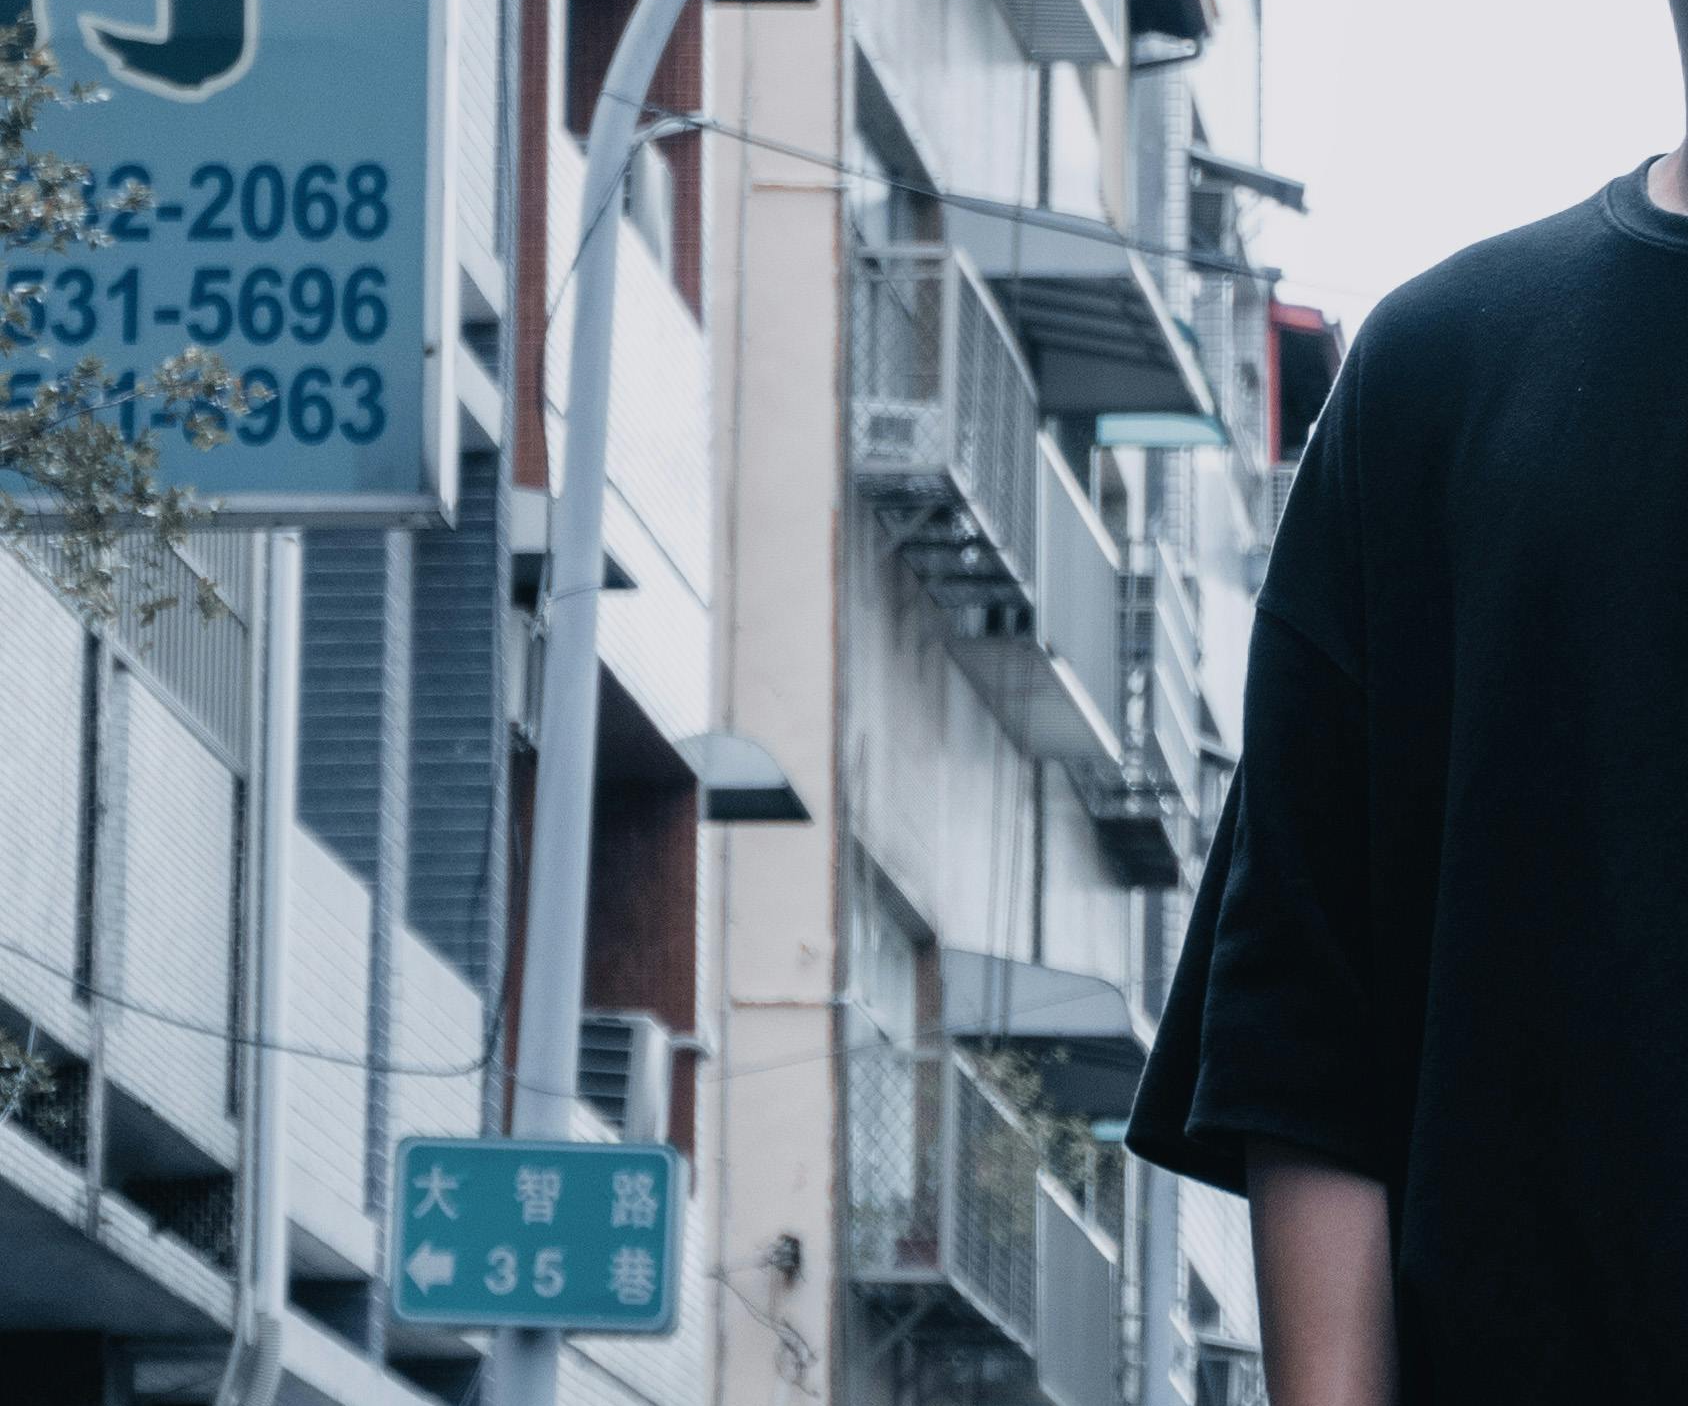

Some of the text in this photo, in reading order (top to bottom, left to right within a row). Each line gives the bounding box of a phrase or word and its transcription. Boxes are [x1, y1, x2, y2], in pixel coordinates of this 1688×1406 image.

[2, 163, 390, 243] 2-2068
[2, 266, 390, 346] 531-5696
[412, 1164, 657, 1229] 大智路
